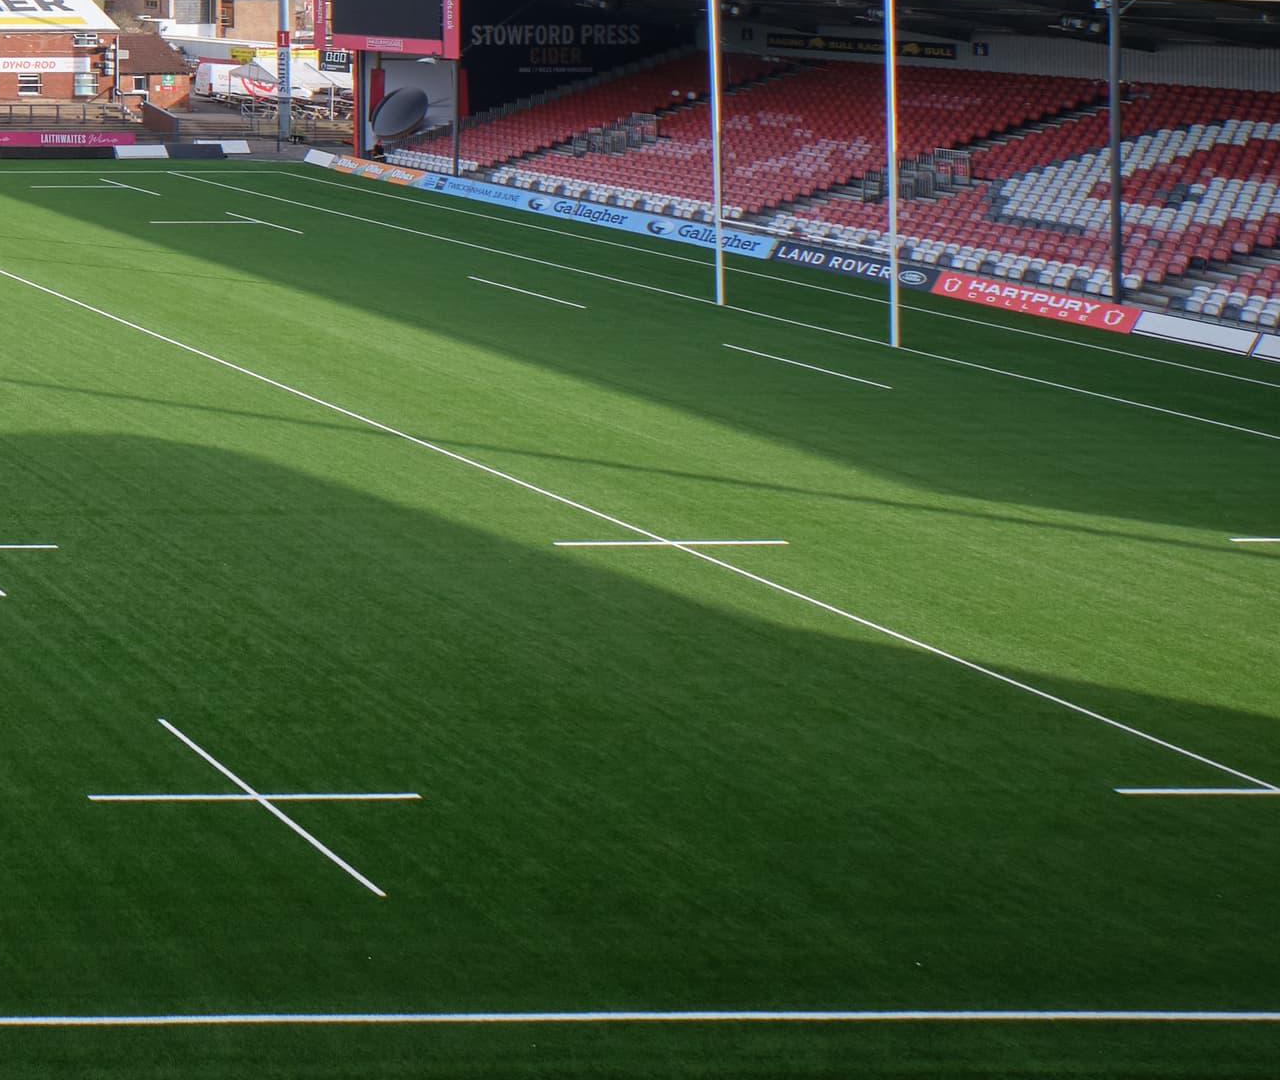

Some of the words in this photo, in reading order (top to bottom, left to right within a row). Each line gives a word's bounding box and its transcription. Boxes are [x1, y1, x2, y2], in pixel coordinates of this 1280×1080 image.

[280, 34, 286, 45] 1
[471, 24, 574, 45] STOWFORD
[581, 24, 640, 45] PRESS
[2, 60, 56, 70] DYNO-ROD
[531, 47, 582, 64] CIDER
[41, 134, 86, 144] LAITHWAITES
[554, 200, 628, 226] Gallagher
[778, 245, 826, 267] LAND
[828, 255, 892, 280] ROVER
[968, 291, 1089, 322] COLLEGE
[969, 279, 1101, 314] HARTPURY
